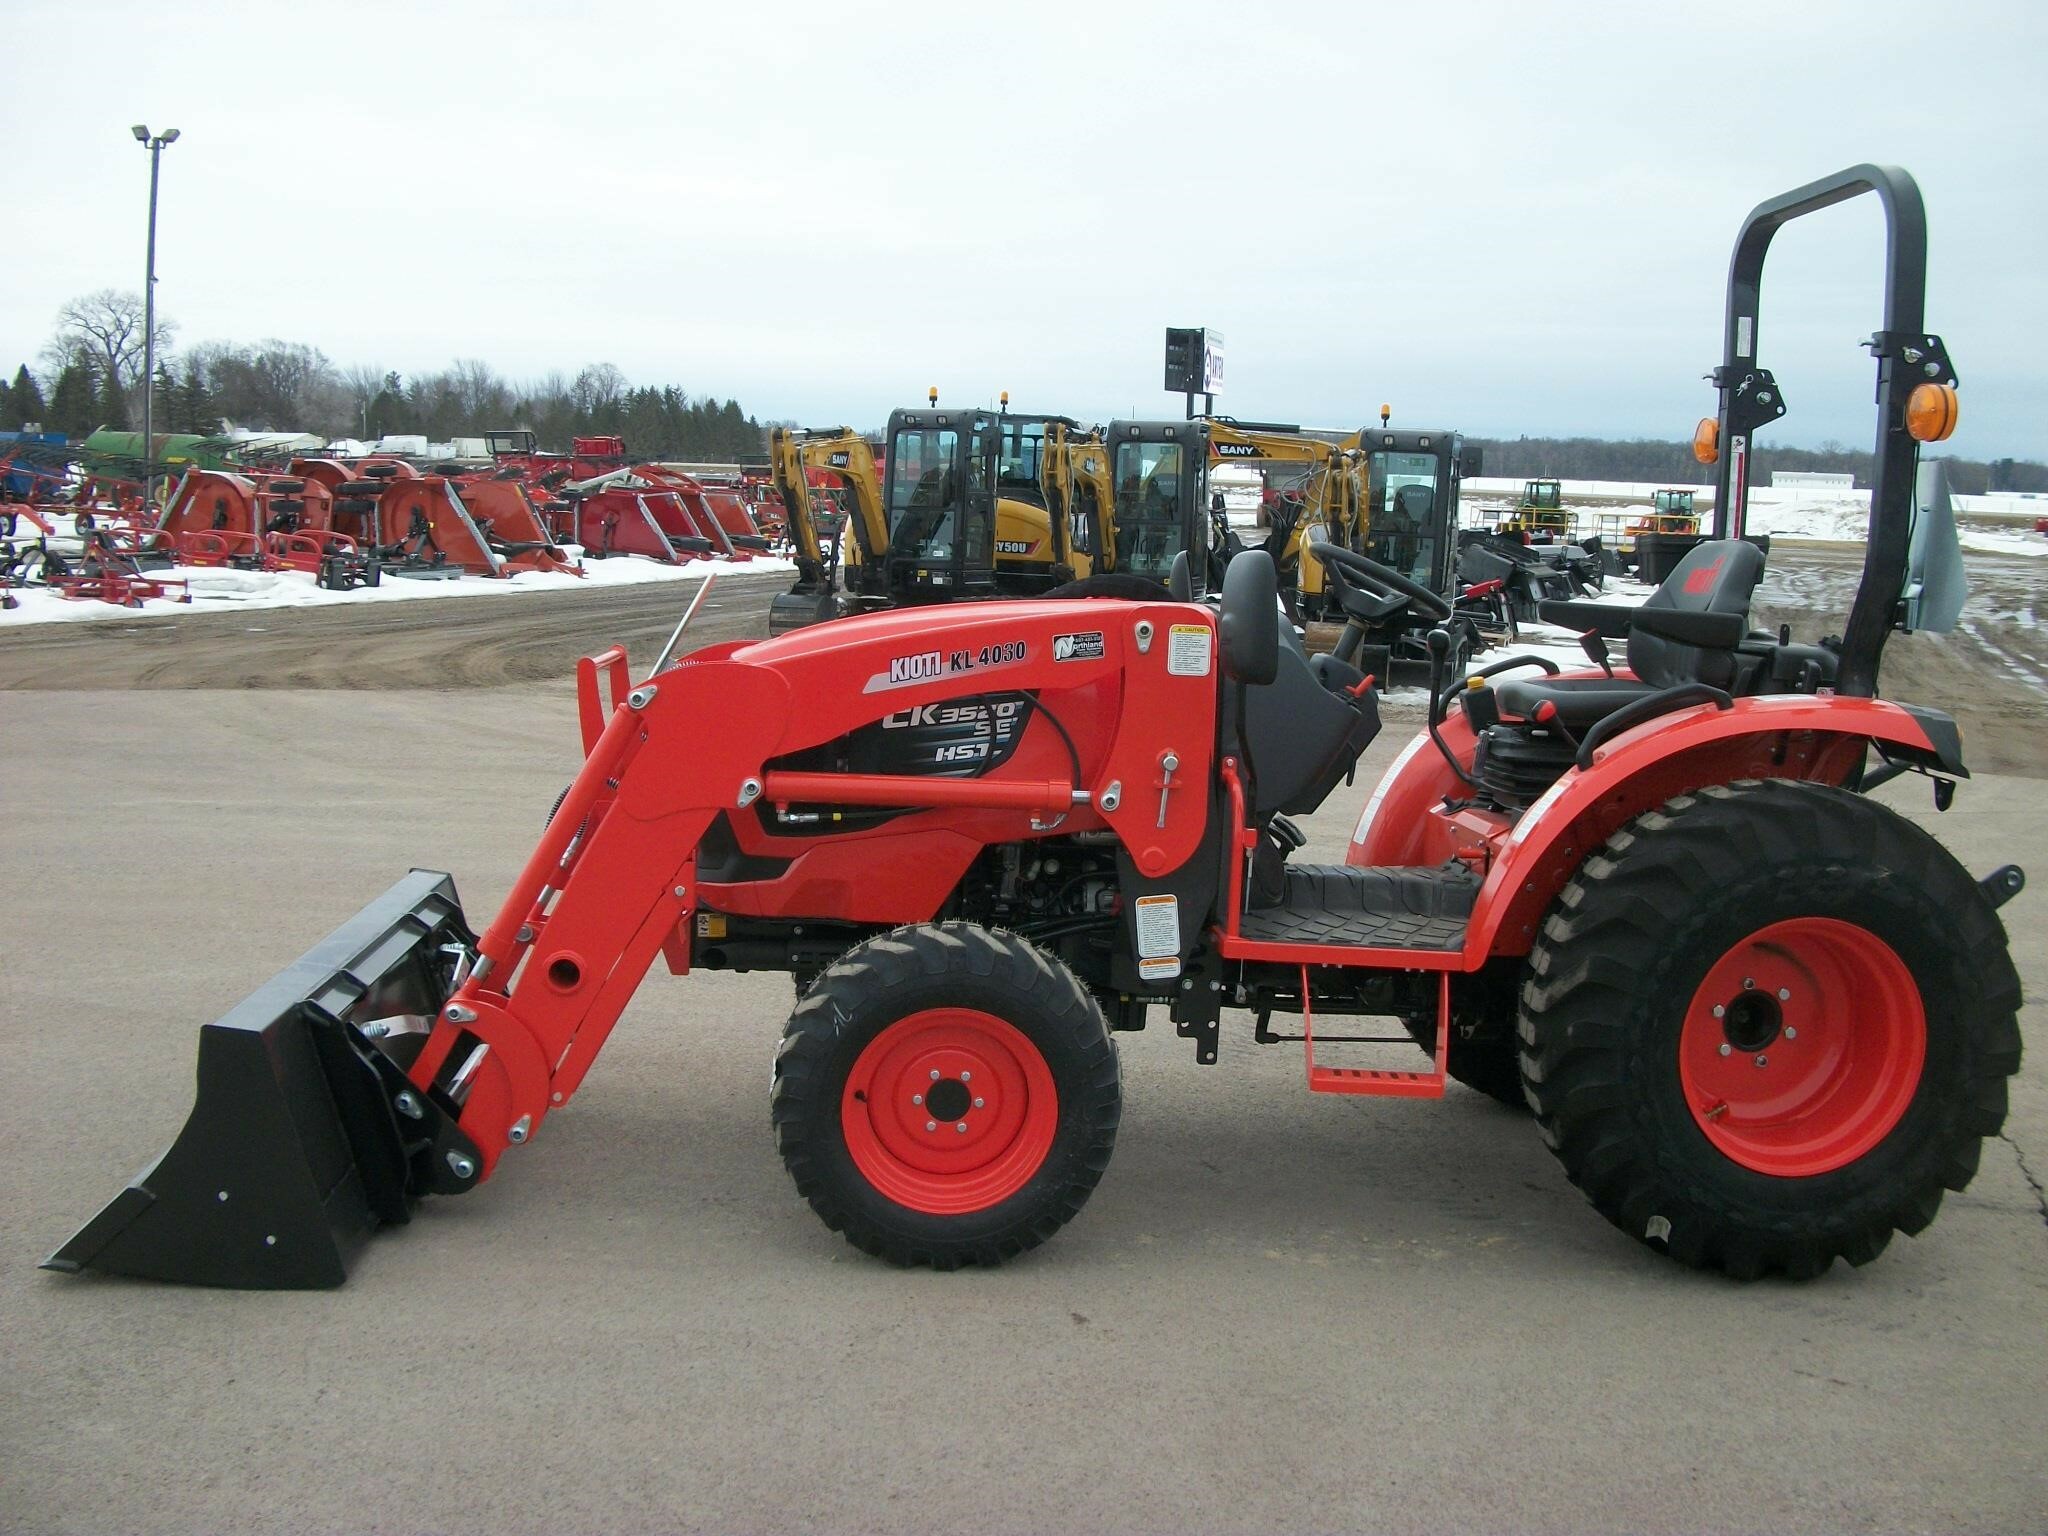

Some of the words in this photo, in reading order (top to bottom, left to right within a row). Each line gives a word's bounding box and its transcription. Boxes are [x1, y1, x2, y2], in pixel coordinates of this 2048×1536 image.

[1220, 445, 1254, 455] SANY
[832, 454, 848, 465] SANY
[996, 541, 1027, 553] Y50U
[890, 650, 941, 683] KIOTI
[950, 650, 975, 672] KL
[978, 641, 1027, 666] 4030
